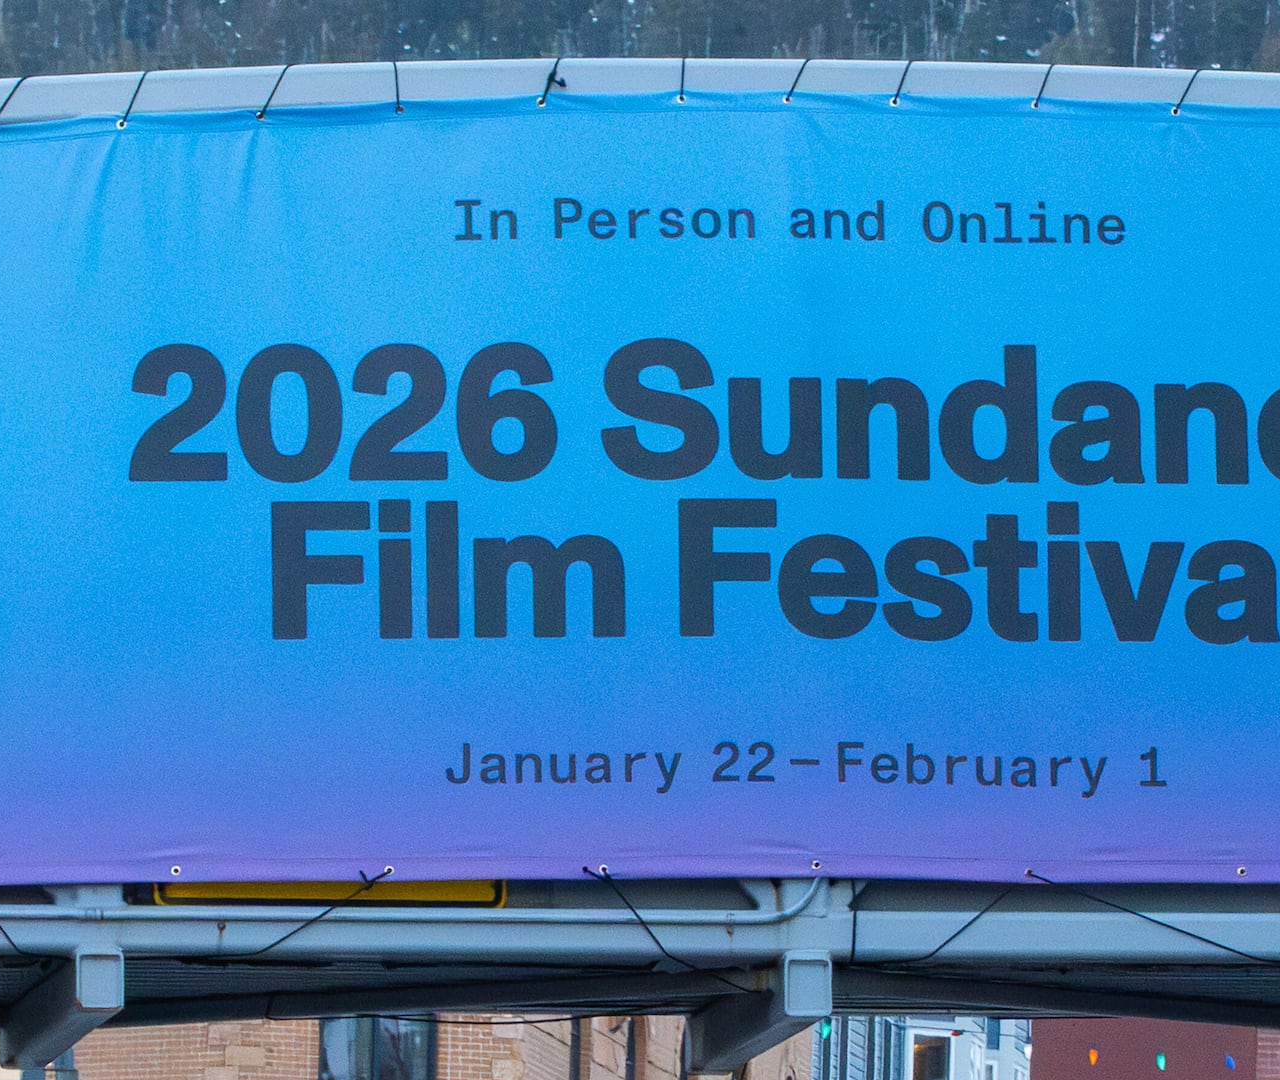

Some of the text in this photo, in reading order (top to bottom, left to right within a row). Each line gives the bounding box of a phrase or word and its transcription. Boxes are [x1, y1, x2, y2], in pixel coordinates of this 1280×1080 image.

[457, 199, 1124, 244] In Person and Online
[129, 343, 557, 482] 2026
[272, 500, 625, 639] Film
[447, 744, 681, 793] January
[1140, 746, 1166, 786] 1
